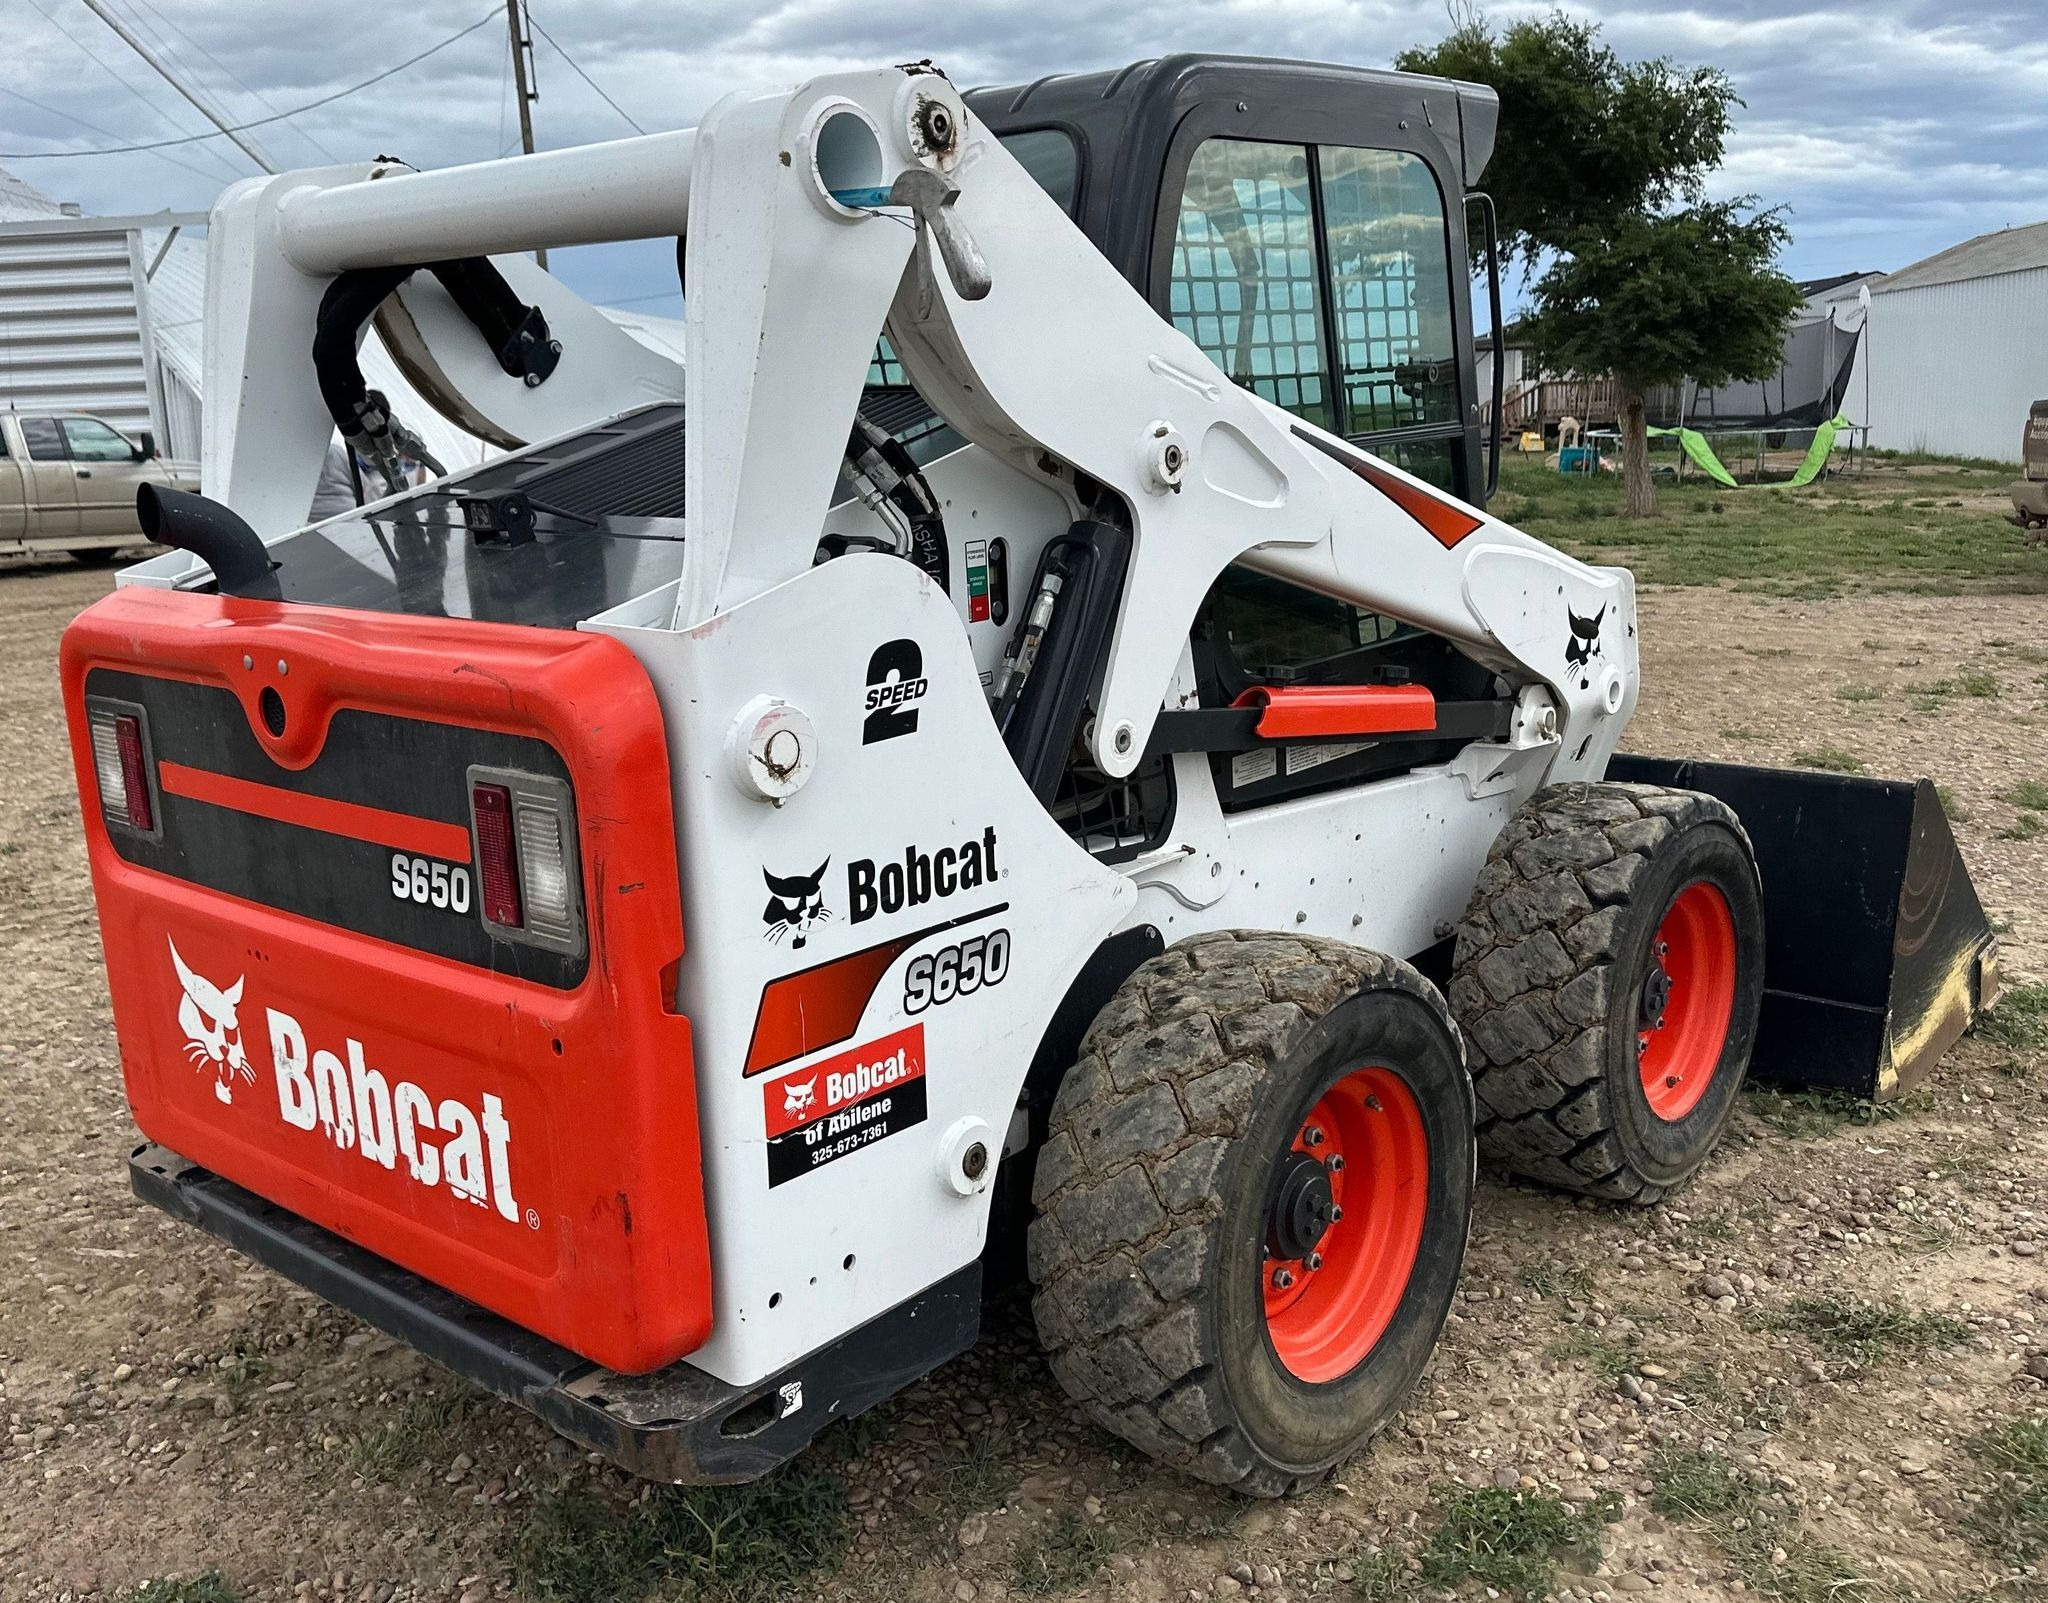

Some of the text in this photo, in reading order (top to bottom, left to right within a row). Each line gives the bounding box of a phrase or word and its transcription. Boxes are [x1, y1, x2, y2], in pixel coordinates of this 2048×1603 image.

[862, 638, 923, 746] 2
[865, 678, 928, 710] SPEED
[391, 853, 470, 914] S650
[847, 826, 998, 925] Bobcat
[903, 928, 1011, 1016] S650
[826, 1047, 907, 1107] Bobcat
[265, 1006, 520, 1223] Bobcat
[805, 1097, 892, 1146] of Abilene
[811, 1121, 888, 1165] 325-673-7361
